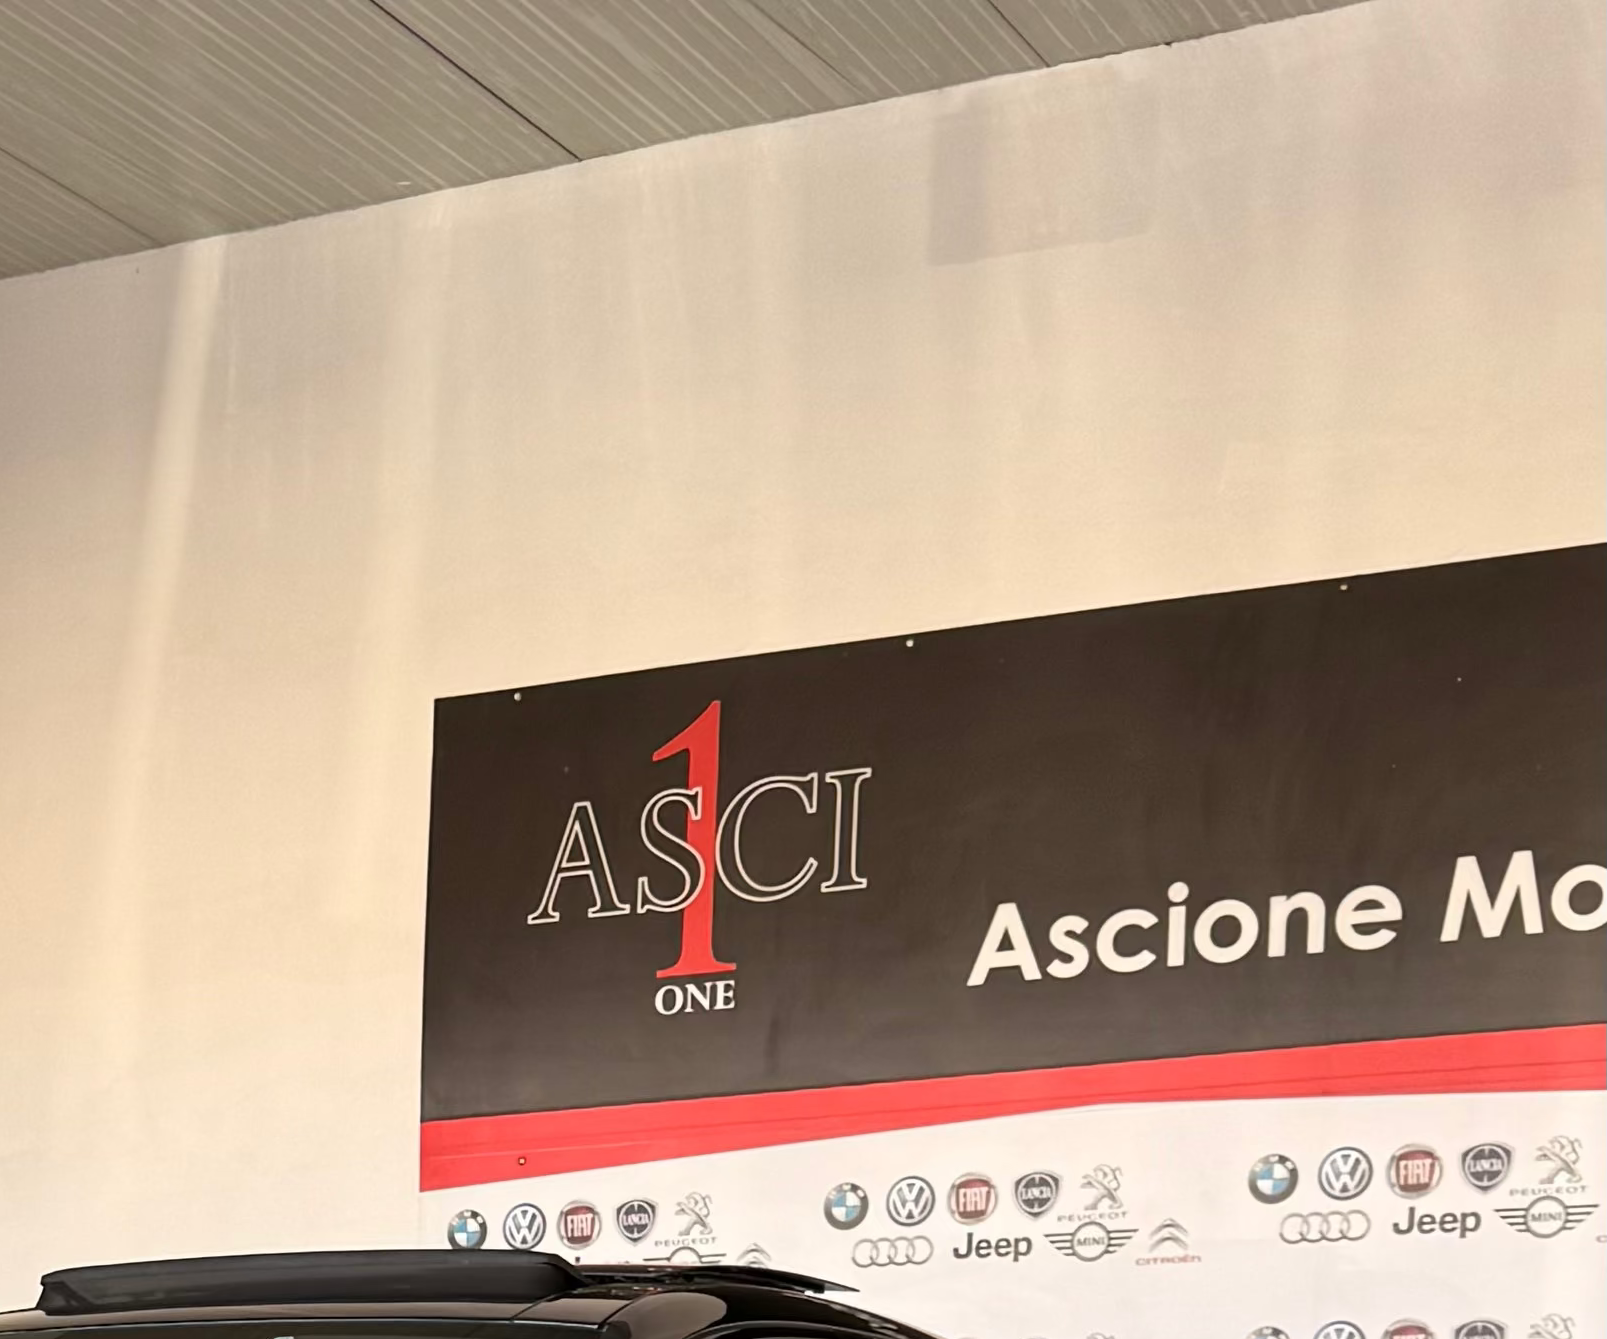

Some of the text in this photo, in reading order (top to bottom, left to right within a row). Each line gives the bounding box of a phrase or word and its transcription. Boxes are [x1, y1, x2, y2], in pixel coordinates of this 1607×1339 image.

[526, 767, 874, 925] ASCI
[965, 881, 1403, 988] Ascione
[653, 978, 736, 1017] ONE
[1399, 1158, 1433, 1185] FIAT
[959, 1186, 990, 1212] FIAT
[1509, 1185, 1589, 1197] PEUGEOT
[566, 1213, 594, 1240] FIAT
[1057, 1210, 1129, 1222] PEUGEOT
[1392, 1206, 1481, 1239] Jeep
[1530, 1211, 1563, 1223] MINI
[654, 1237, 717, 1248] PEUGEOT
[952, 1231, 1033, 1263] Jeep
[1076, 1236, 1106, 1248] MINI
